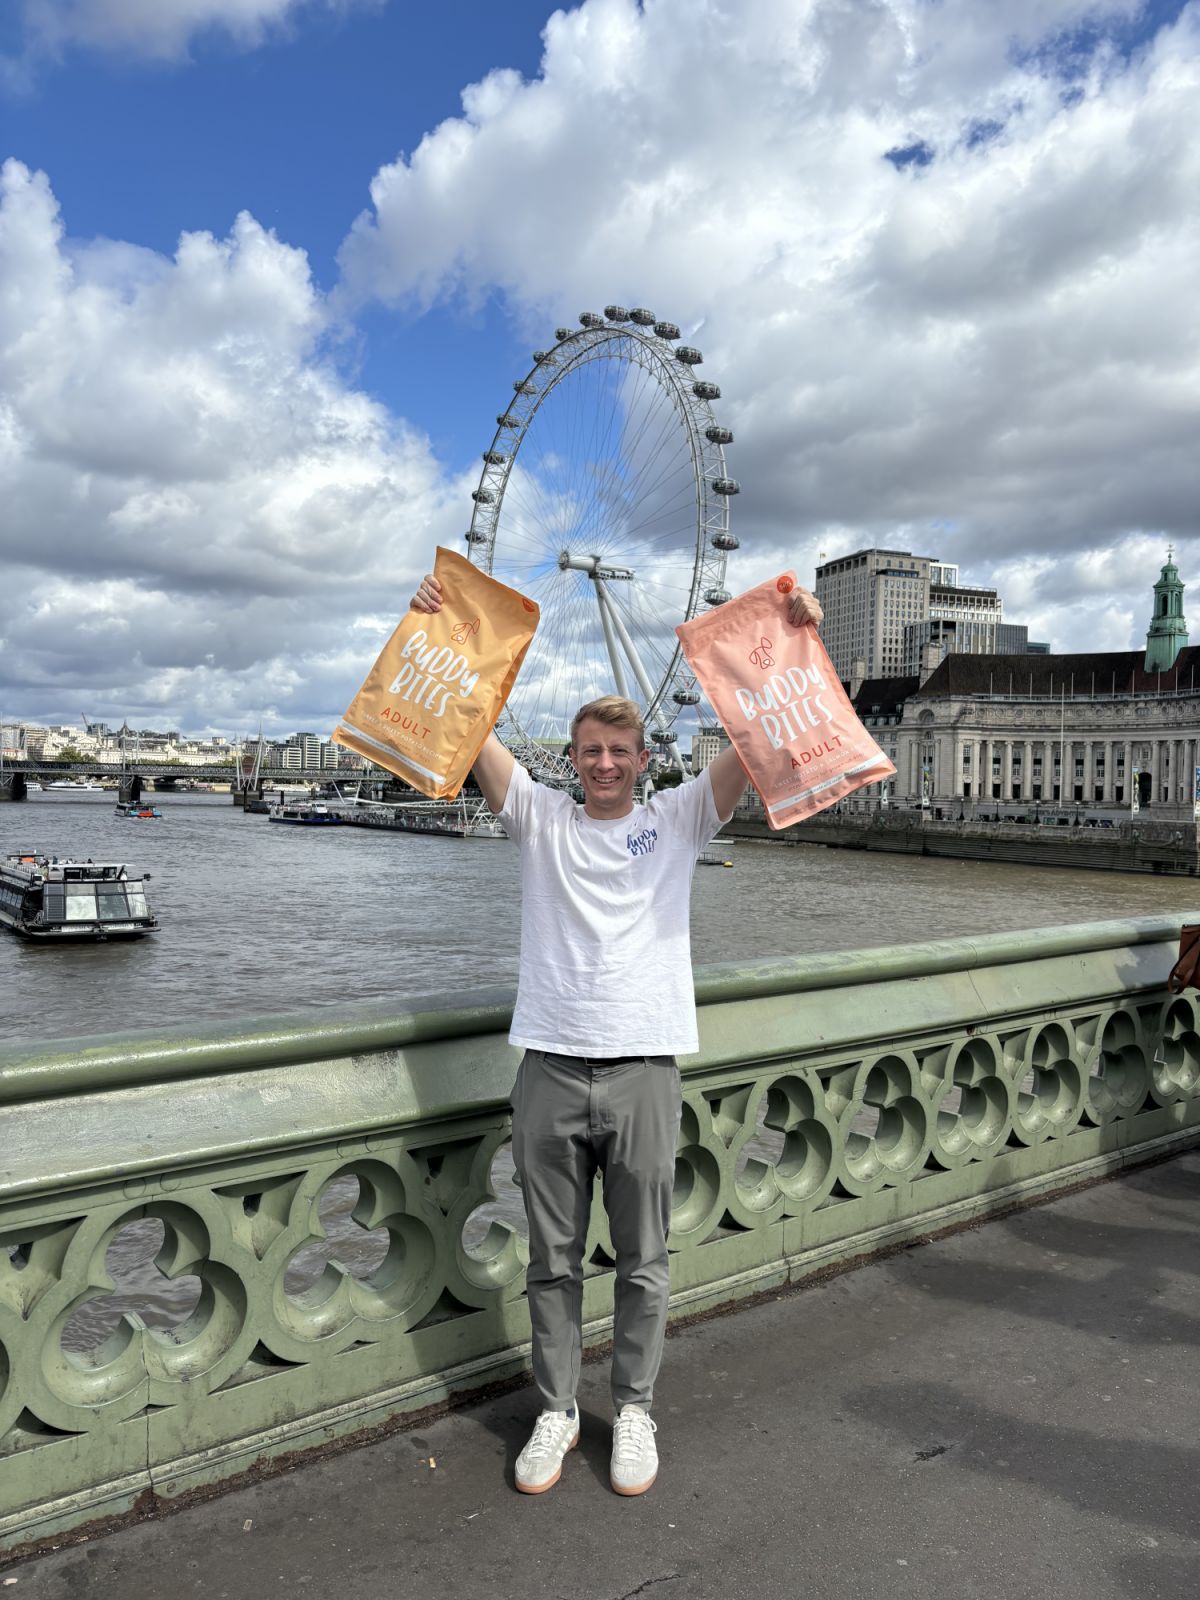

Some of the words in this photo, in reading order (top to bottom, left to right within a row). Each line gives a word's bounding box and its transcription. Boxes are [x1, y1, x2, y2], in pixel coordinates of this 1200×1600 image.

[388, 662, 455, 718] BITES
[380, 707, 431, 739] ADULT
[760, 694, 834, 750] BITES
[791, 735, 842, 770] ADULT
